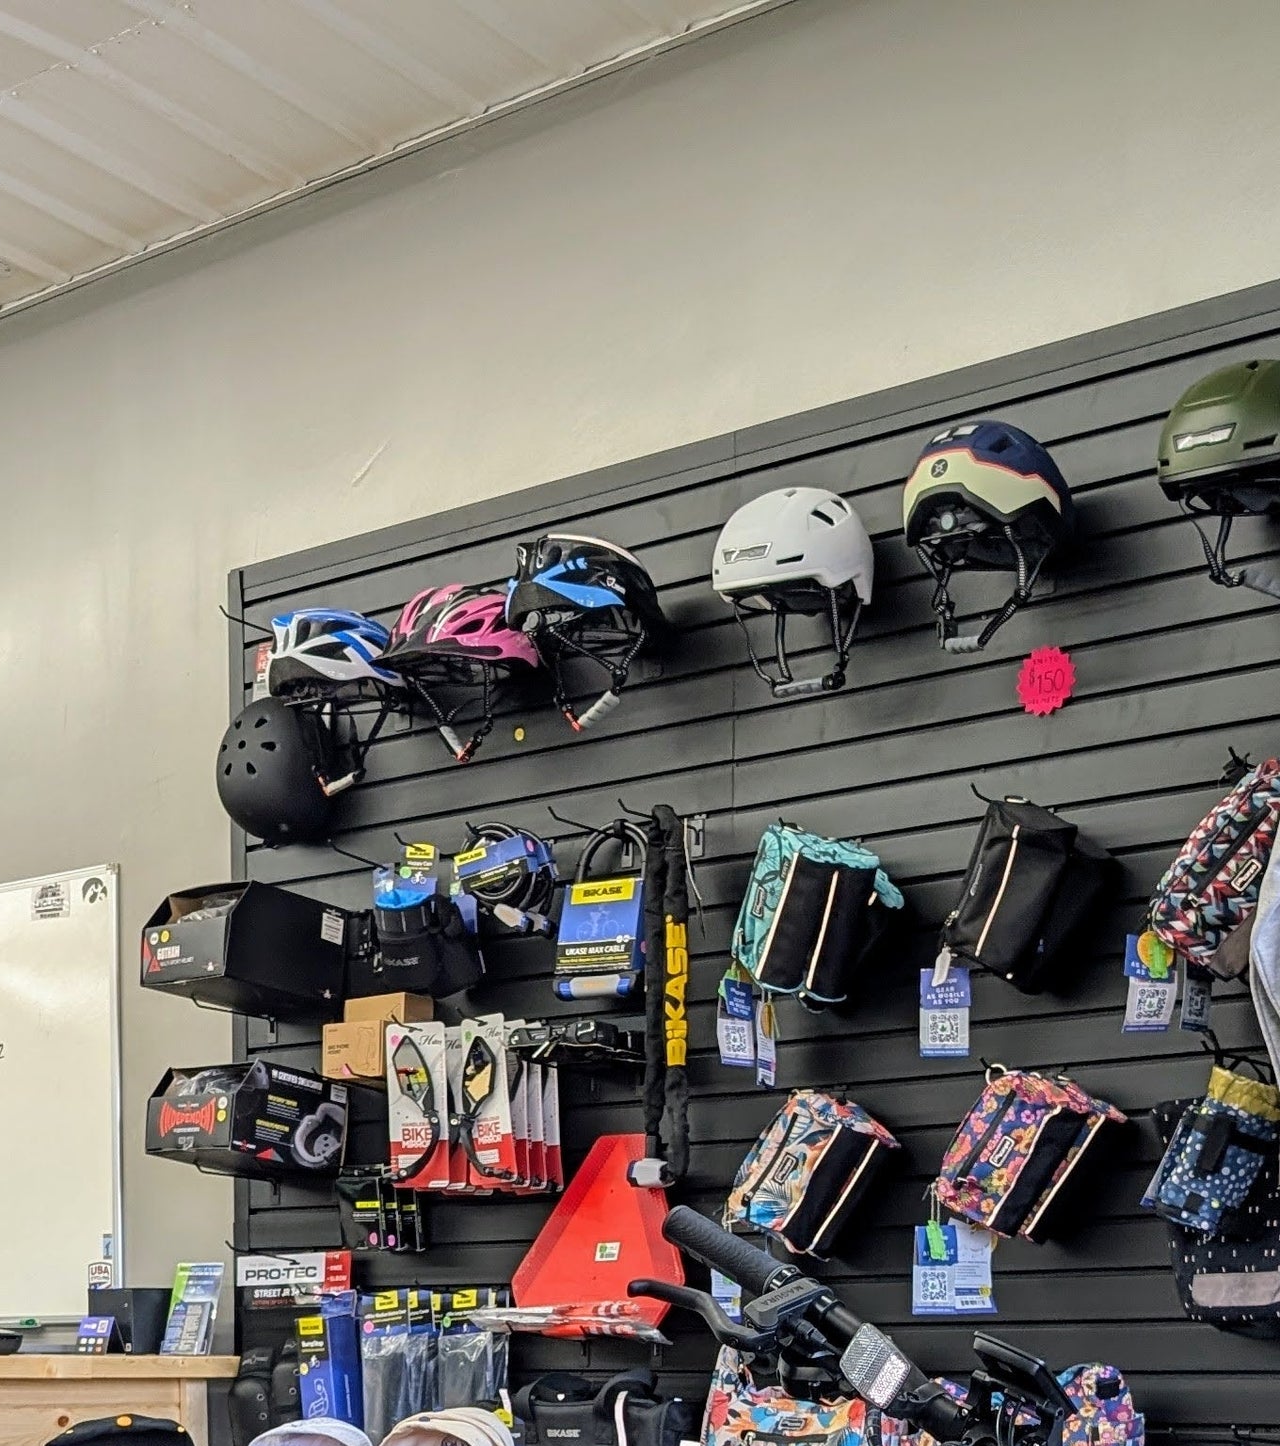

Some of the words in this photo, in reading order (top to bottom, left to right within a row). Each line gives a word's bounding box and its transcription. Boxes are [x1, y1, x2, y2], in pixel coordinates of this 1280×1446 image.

[1029, 667, 1065, 695] $150
[402, 1128, 432, 1142] BIKE
[477, 1122, 501, 1137] BIKE
[245, 1266, 318, 1281] PRO-TEC
[254, 1288, 280, 1299] STREET
